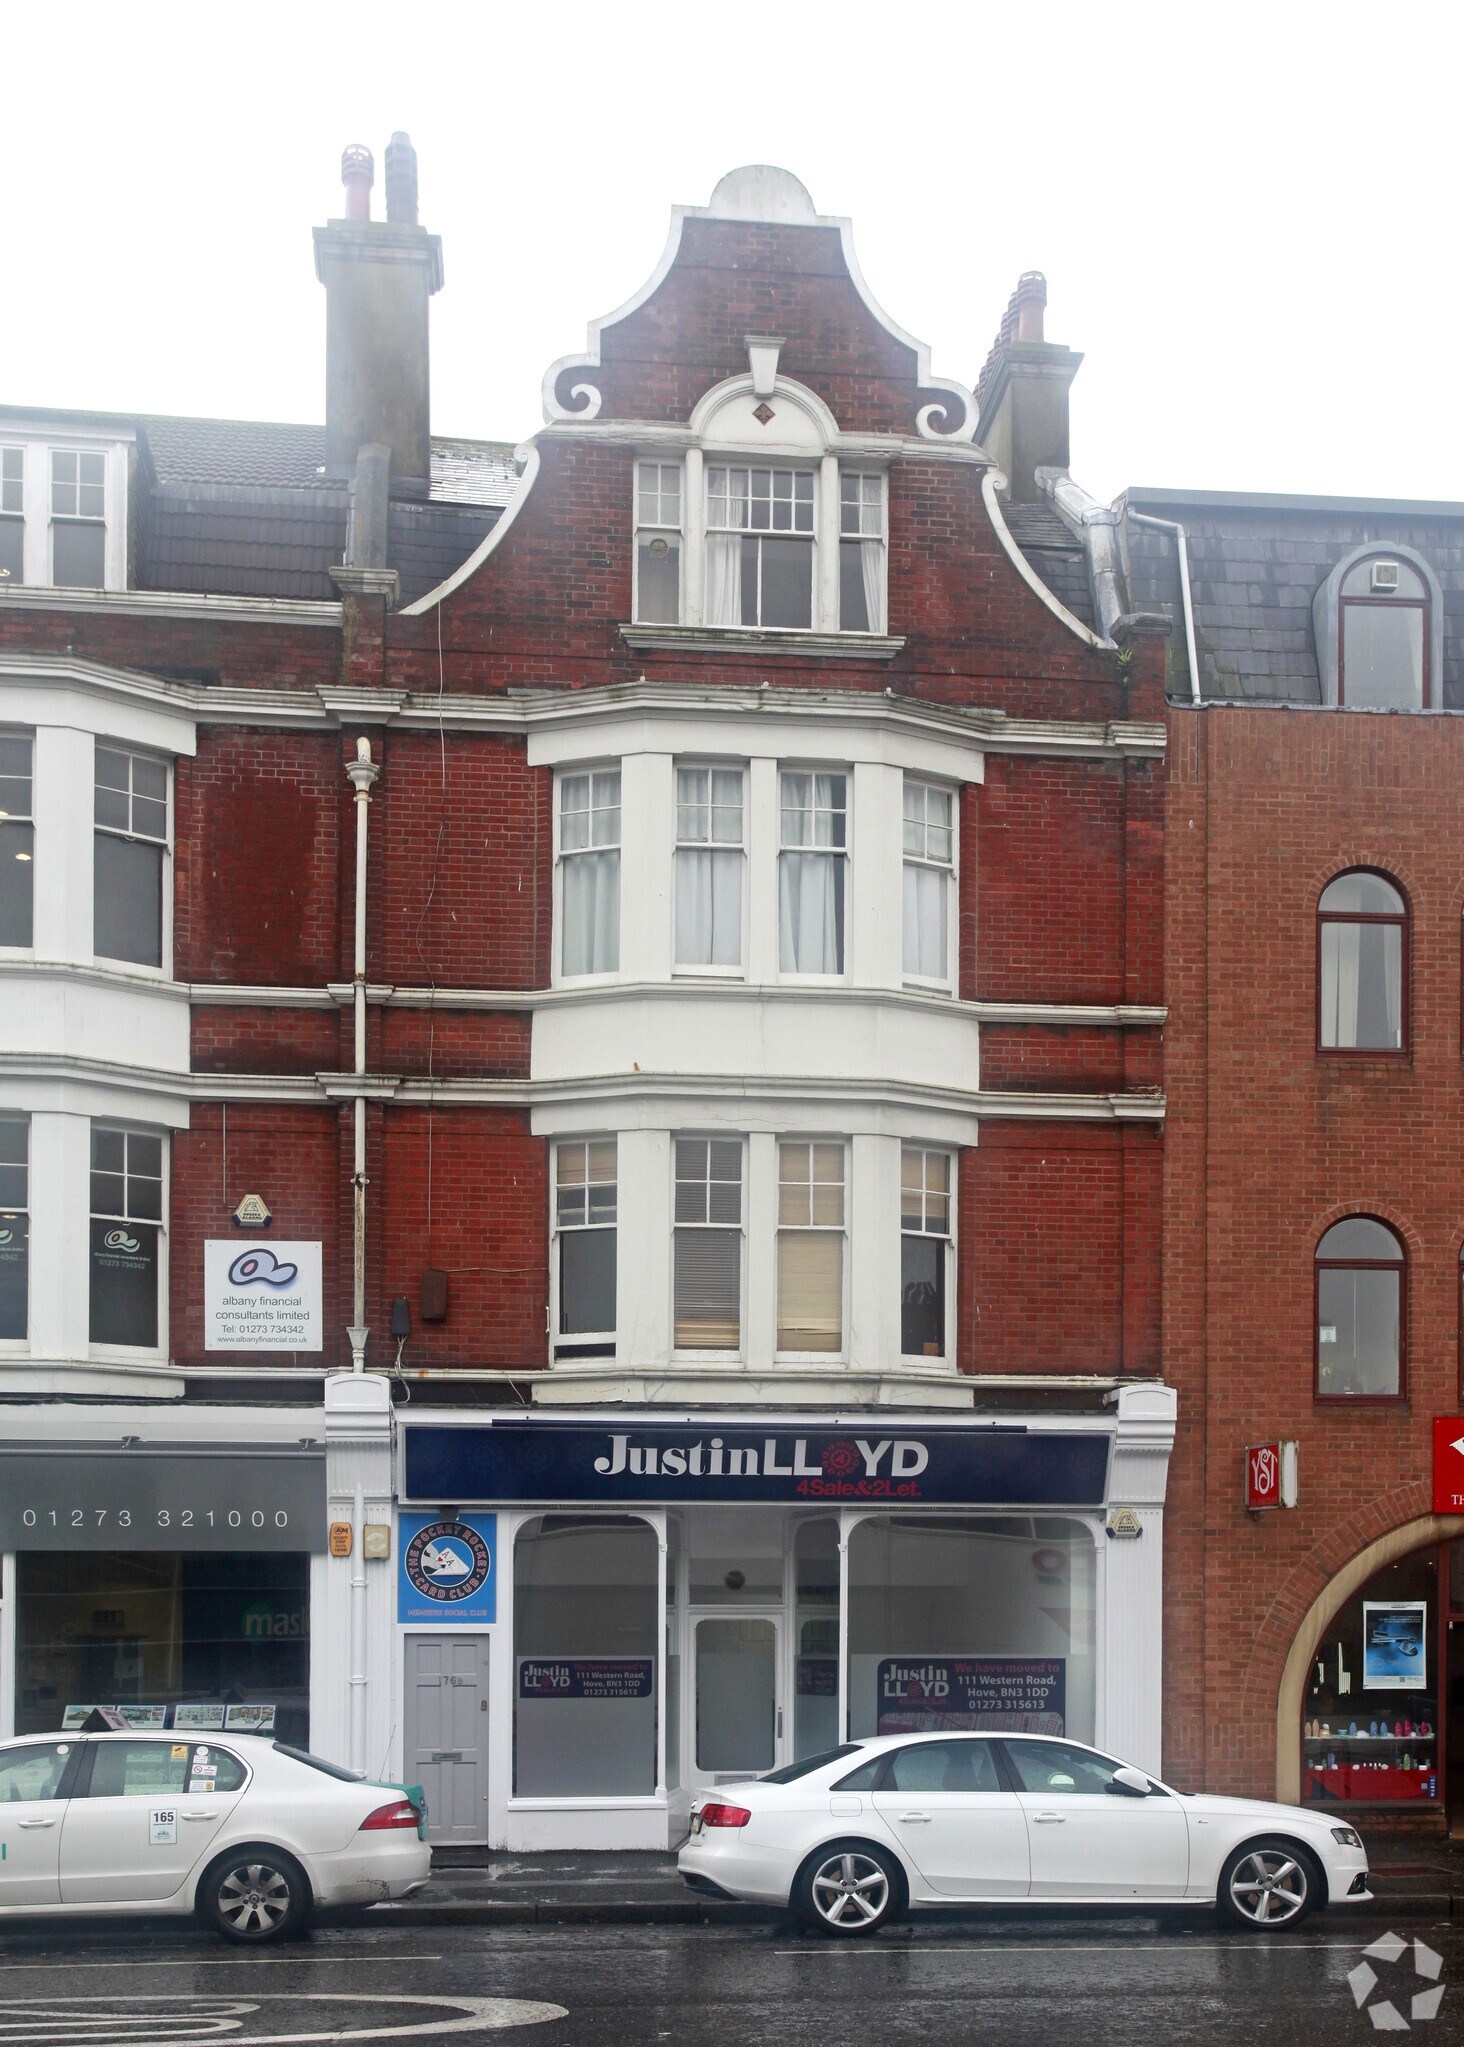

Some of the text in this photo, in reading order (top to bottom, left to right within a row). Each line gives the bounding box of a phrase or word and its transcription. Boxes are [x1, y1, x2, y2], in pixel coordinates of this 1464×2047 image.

[222, 1296, 302, 1308] albany financial
[215, 1310, 310, 1320] consultants limited
[221, 1324, 304, 1334] Tel: 01273 734342
[1250, 1448, 1278, 1495] YST
[22, 1509, 288, 1528] 01273 321000
[408, 1524, 488, 1576] THE POCKET ROCKET
[415, 1577, 480, 1599] CARD CLUB
[523, 1664, 569, 1676] Justin
[883, 1664, 948, 1681] Justin
[954, 1662, 1060, 1673] We have moved to
[958, 1675, 1057, 1686] 111 Western Road,
[583, 1688, 638, 1696] 01273 315613
[967, 1688, 1049, 1698] Hove, BN3 1DD
[968, 1700, 1045, 1710] 01273 315613
[153, 1811, 175, 1823] 165
